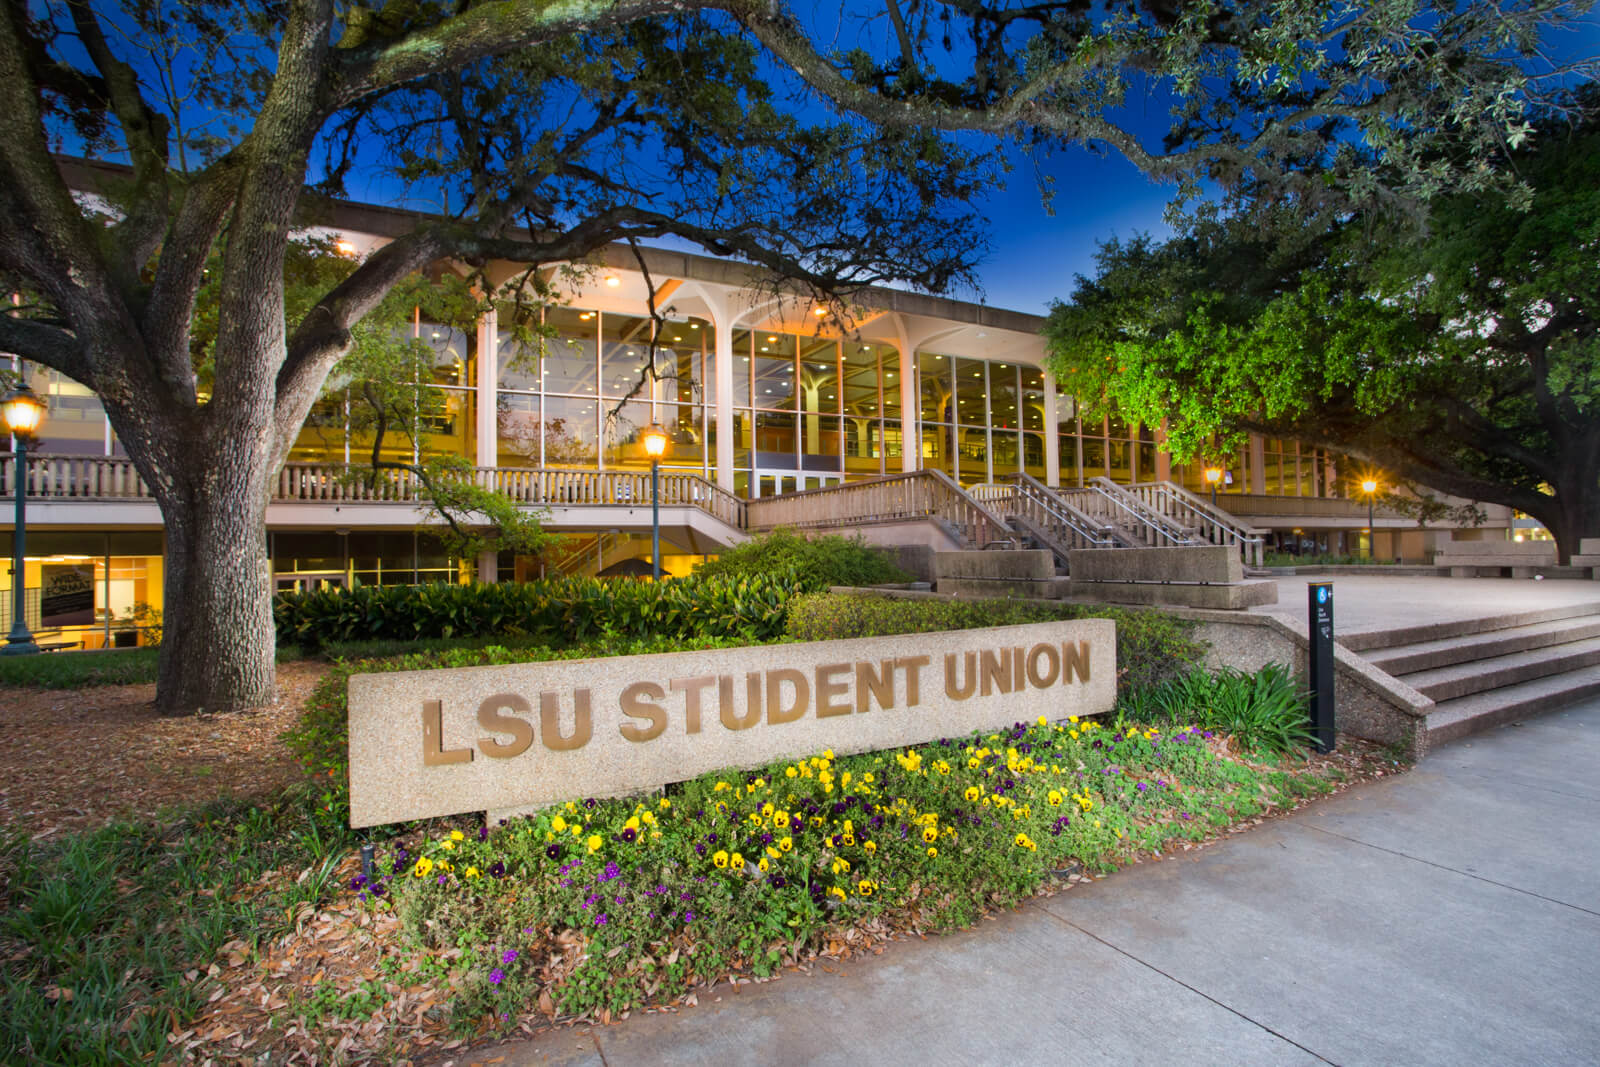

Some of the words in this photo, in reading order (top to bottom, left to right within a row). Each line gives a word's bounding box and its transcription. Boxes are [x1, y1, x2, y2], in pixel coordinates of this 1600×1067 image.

[51, 573, 81, 585] WIDE
[46, 580, 91, 596] FORMAT
[423, 687, 593, 766] LSU
[619, 655, 930, 743] STUDENT
[944, 640, 1091, 701] UNION
